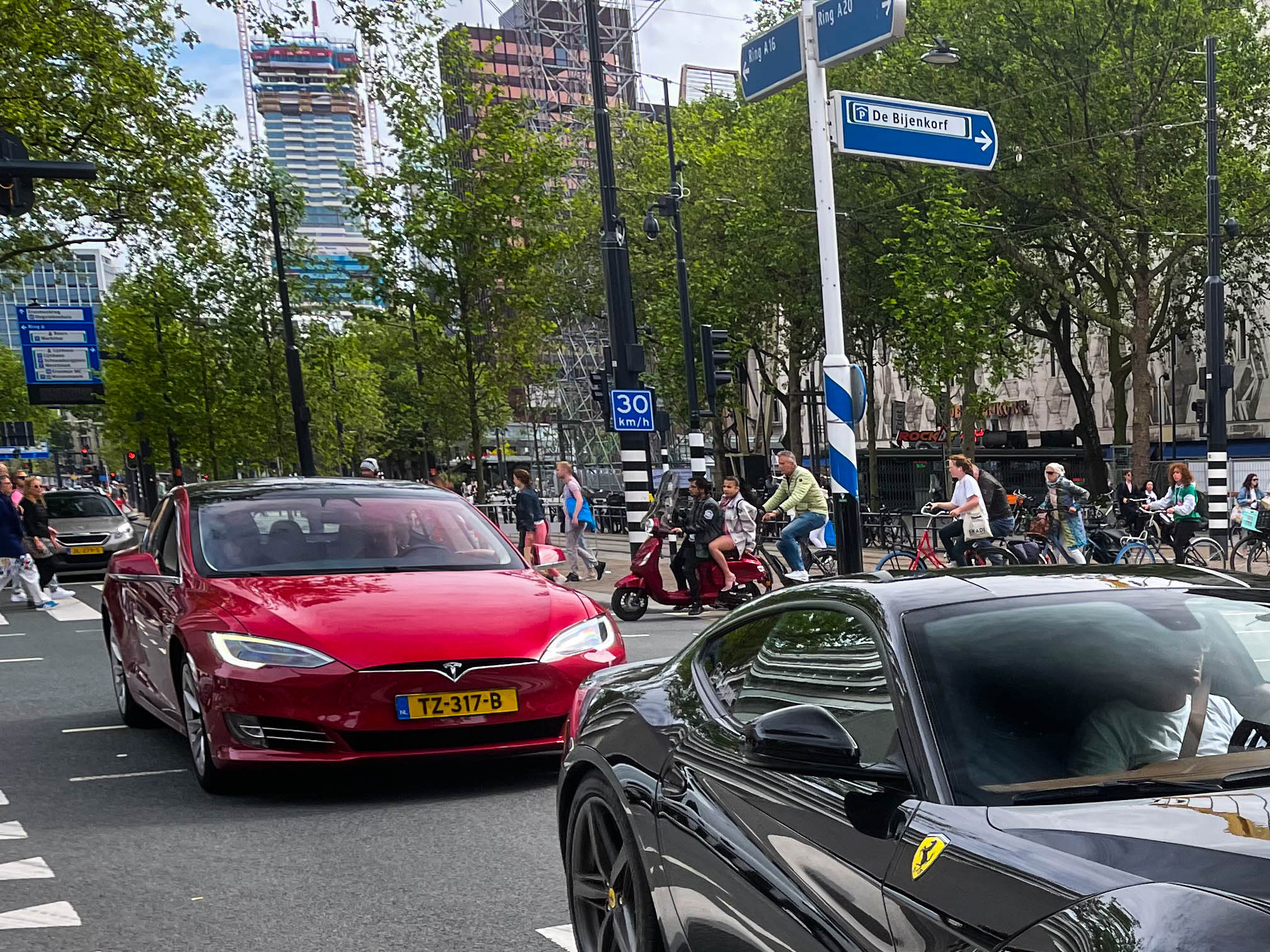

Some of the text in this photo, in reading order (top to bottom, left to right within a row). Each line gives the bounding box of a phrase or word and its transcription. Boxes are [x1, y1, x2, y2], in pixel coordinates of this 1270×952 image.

[818, 0, 853, 28] Ring A20
[748, 36, 776, 62] Ring A16
[872, 110, 888, 123] De
[892, 112, 949, 131] Bijenkorf
[617, 394, 649, 414] 30
[619, 417, 650, 428] km/h
[418, 692, 502, 715] TZ-317-B
